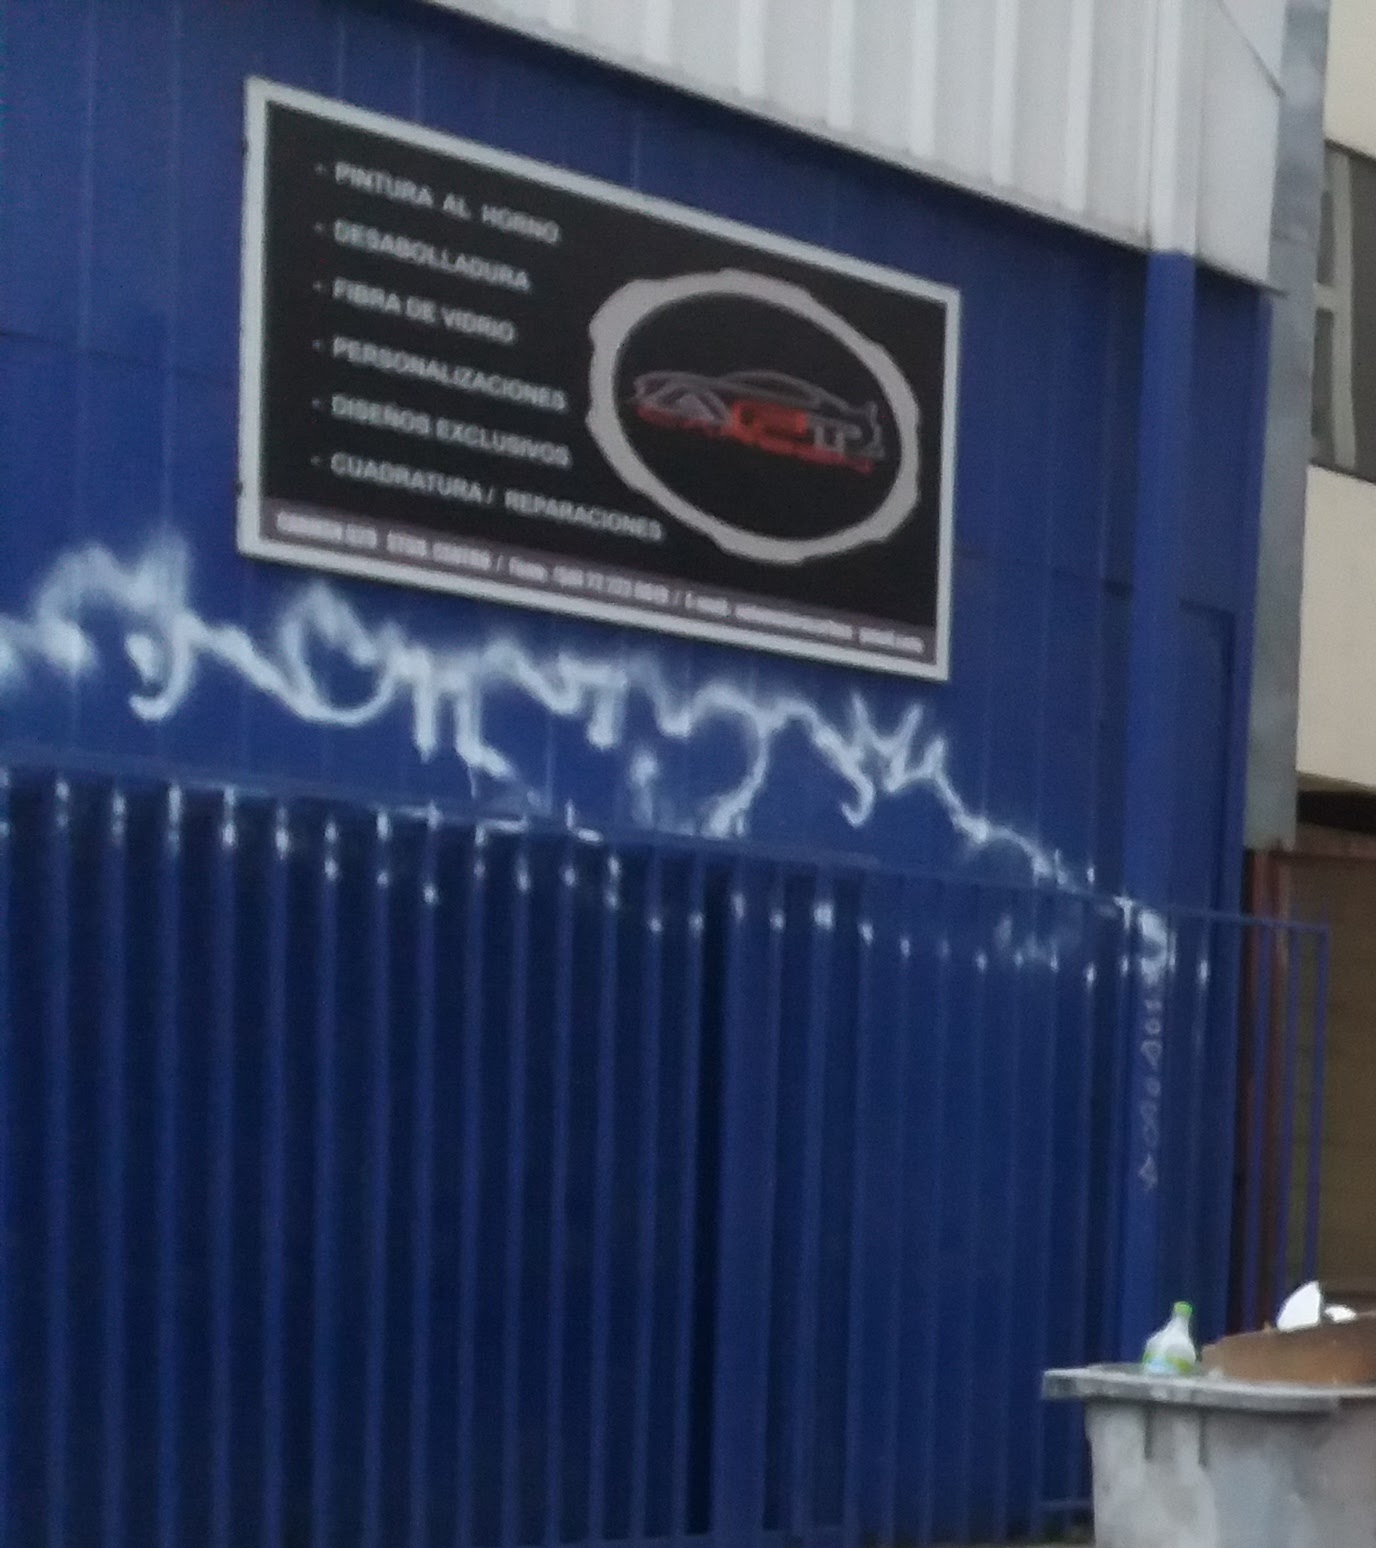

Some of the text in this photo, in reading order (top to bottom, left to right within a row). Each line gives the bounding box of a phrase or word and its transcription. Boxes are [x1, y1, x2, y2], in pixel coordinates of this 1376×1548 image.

[334, 160, 561, 246] PINTURA AL HORNO
[333, 217, 531, 294] DESABOLLADURA
[332, 276, 517, 346] FIBRA DE VIDRIO
[332, 336, 568, 414] PERSONALIZACIONES
[436, 417, 572, 468] EXCLUSIVOS
[504, 489, 664, 543] REPARACIONES
